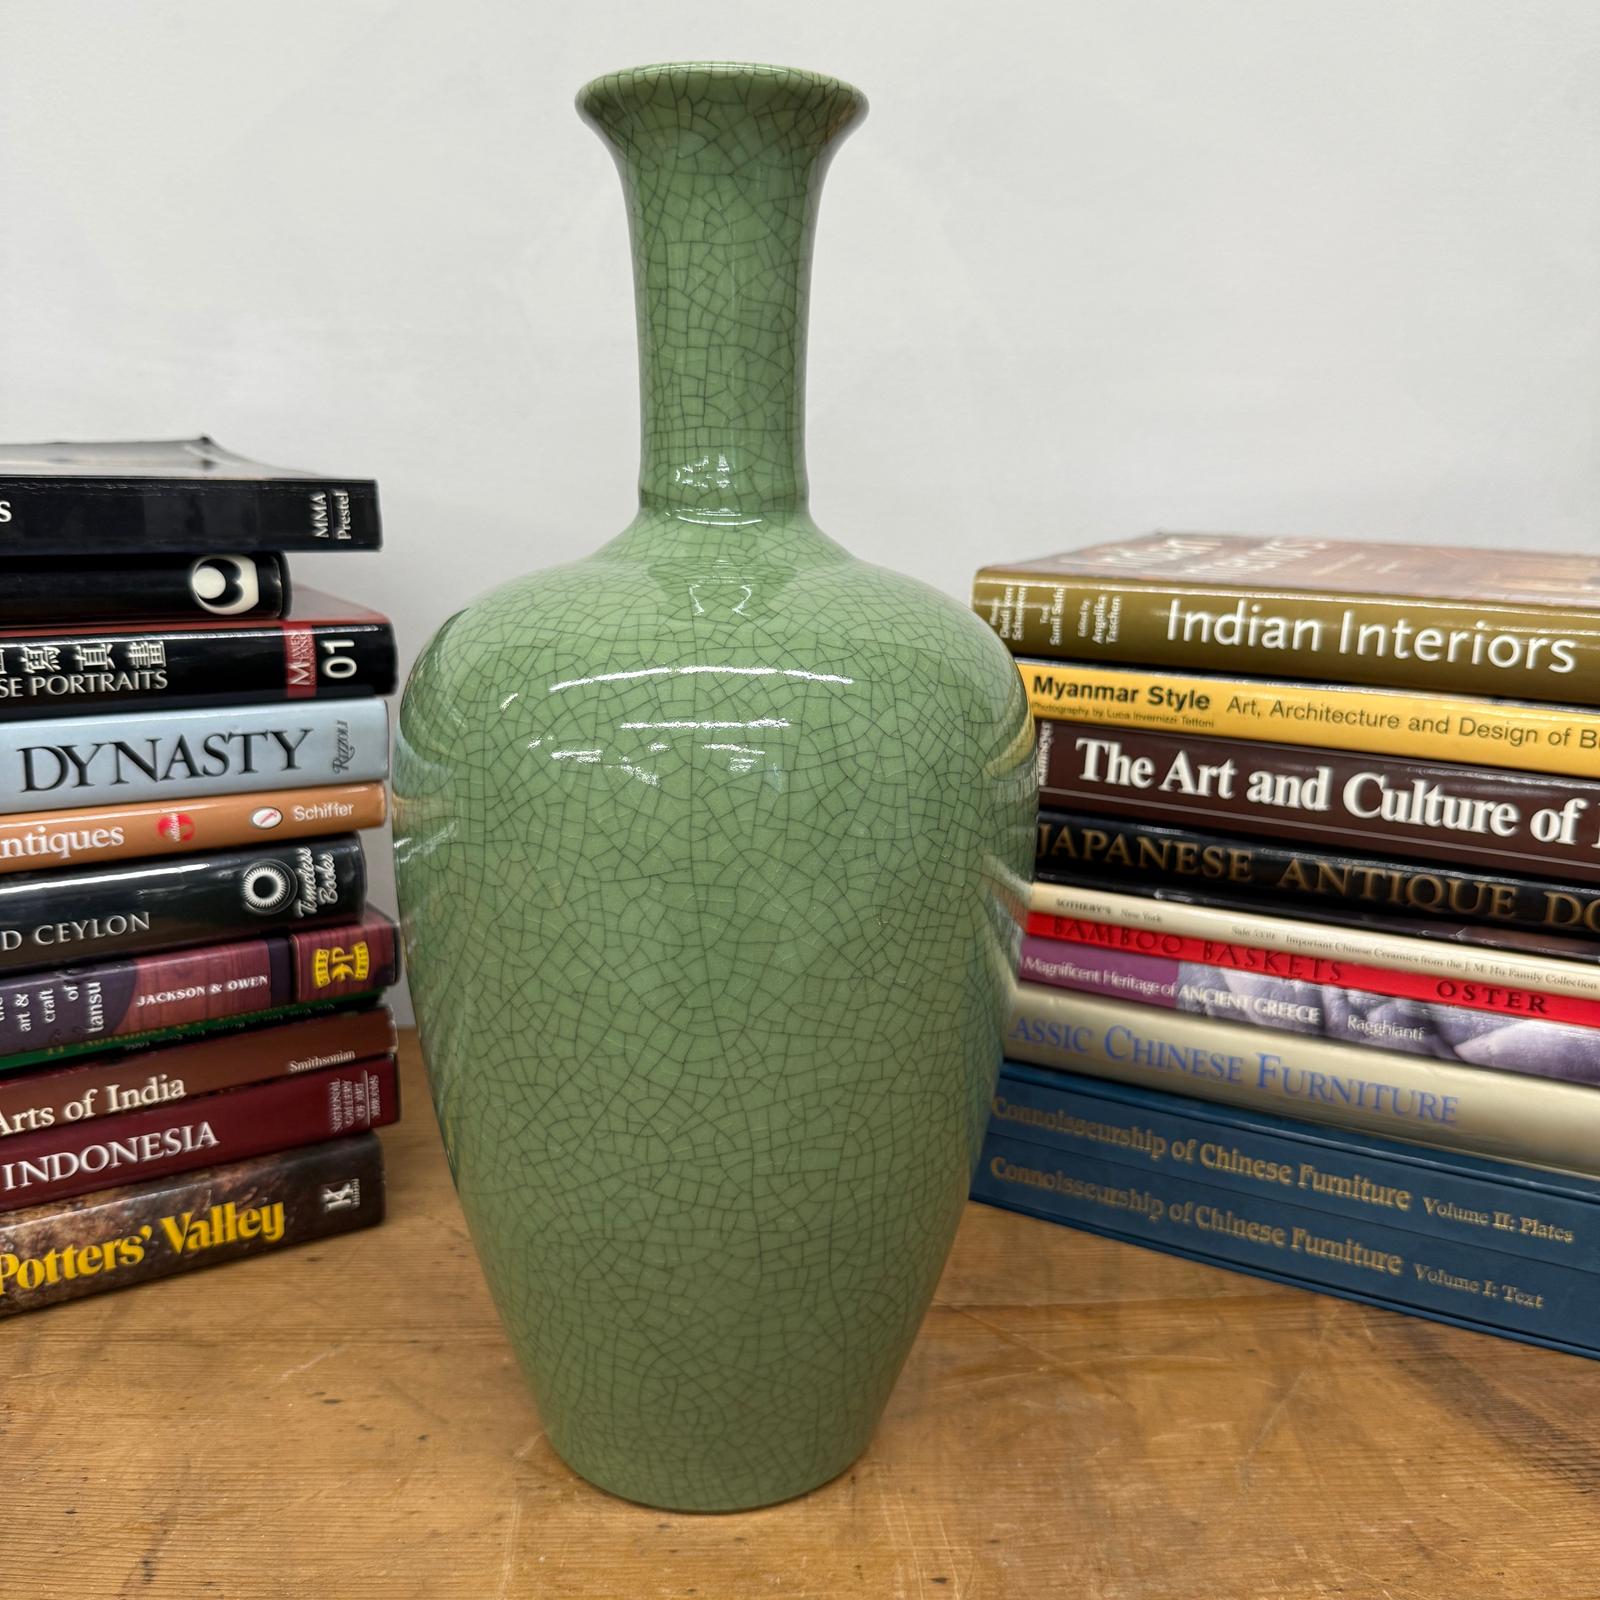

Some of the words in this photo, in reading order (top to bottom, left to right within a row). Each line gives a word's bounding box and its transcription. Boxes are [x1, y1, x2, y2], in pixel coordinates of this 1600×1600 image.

[310, 491, 328, 538] MMA
[336, 487, 352, 541] Prestel
[1050, 616, 1062, 646] Sunil
[1092, 594, 1108, 644] Angelika
[1106, 595, 1121, 644] Taschen
[1166, 598, 1320, 652] Indian
[1338, 609, 1578, 674] Interiors
[31, 669, 168, 696] PORTRAITS
[320, 639, 358, 679] 01
[1033, 675, 1138, 705] Myanmar
[1147, 685, 1211, 712] Style
[1226, 695, 1261, 719] Art,
[1269, 699, 1400, 730] Architecture
[1408, 715, 1450, 736] and
[1459, 717, 1538, 747] Design
[1548, 727, 1571, 747] of
[1580, 729, 1600, 750] B
[1092, 708, 1104, 721] by
[1106, 709, 1130, 720] Luca
[1133, 711, 1178, 725] Invernizzi
[17, 728, 313, 793] DYNASTY
[293, 800, 354, 823] Schiffer
[1075, 737, 1156, 790] The
[1158, 749, 1240, 800] Art
[1247, 766, 1333, 812] and
[1343, 771, 1522, 838] Culture
[1529, 797, 1590, 846] of
[296, 846, 318, 919] Timeless
[314, 851, 338, 905] Books
[1036, 823, 1254, 884] JAPANESE
[1276, 856, 1521, 920] ANTIQUE
[1, 930, 22, 951] D
[34, 911, 151, 946] CEYLON
[1120, 908, 1140, 920] New
[1142, 910, 1163, 924] York
[1286, 934, 1333, 951] Important
[1335, 941, 1372, 956] Chinese
[1373, 946, 1420, 966] Ceramics
[1421, 953, 1445, 968] from
[1446, 957, 1462, 969] the
[1473, 962, 1485, 974] M.
[1489, 964, 1506, 977] Hu
[1508, 968, 1542, 984] Family
[1545, 974, 1598, 990] Collection
[1052, 915, 1184, 954] BAMBOO
[1203, 940, 1343, 982] BASKETS
[1436, 980, 1550, 1015] OSTER
[14, 992, 30, 1008] &
[39, 987, 56, 1024] craft
[61, 985, 80, 1002] of
[135, 985, 207, 1008] JACKSON
[209, 983, 223, 994] &
[226, 975, 269, 992] OWEN
[1023, 957, 1100, 985] Magnificent
[1102, 967, 1160, 996] Heritage
[1160, 982, 1178, 997] of
[1178, 983, 1252, 1010] ANCIENT
[1253, 996, 1321, 1025] GREECE
[1347, 1014, 1427, 1042] Ragghianti
[17, 1010, 32, 1033] art
[287, 1049, 356, 1074] Smithsonian
[63, 1088, 98, 1121] of
[105, 1073, 188, 1114] India
[2, 1121, 220, 1191] INDONESIA
[991, 1095, 1168, 1159] Connoisseurship
[1170, 1138, 1198, 1164] of
[1199, 1142, 1293, 1186] Chinese
[1298, 1163, 1413, 1211] Furniture
[1423, 1196, 1489, 1226] Volume
[1492, 1211, 1516, 1231] II:
[1519, 1216, 1576, 1245] Plates
[159, 1202, 286, 1256] Valley
[990, 1156, 1165, 1224] Connoisseurship
[1168, 1200, 1195, 1224] of
[1194, 1204, 1288, 1249] Chinese
[1291, 1226, 1406, 1276] Furniture
[1413, 1263, 1480, 1293] Volume
[1483, 1279, 1498, 1298] I:
[1502, 1284, 1545, 1309] Text
